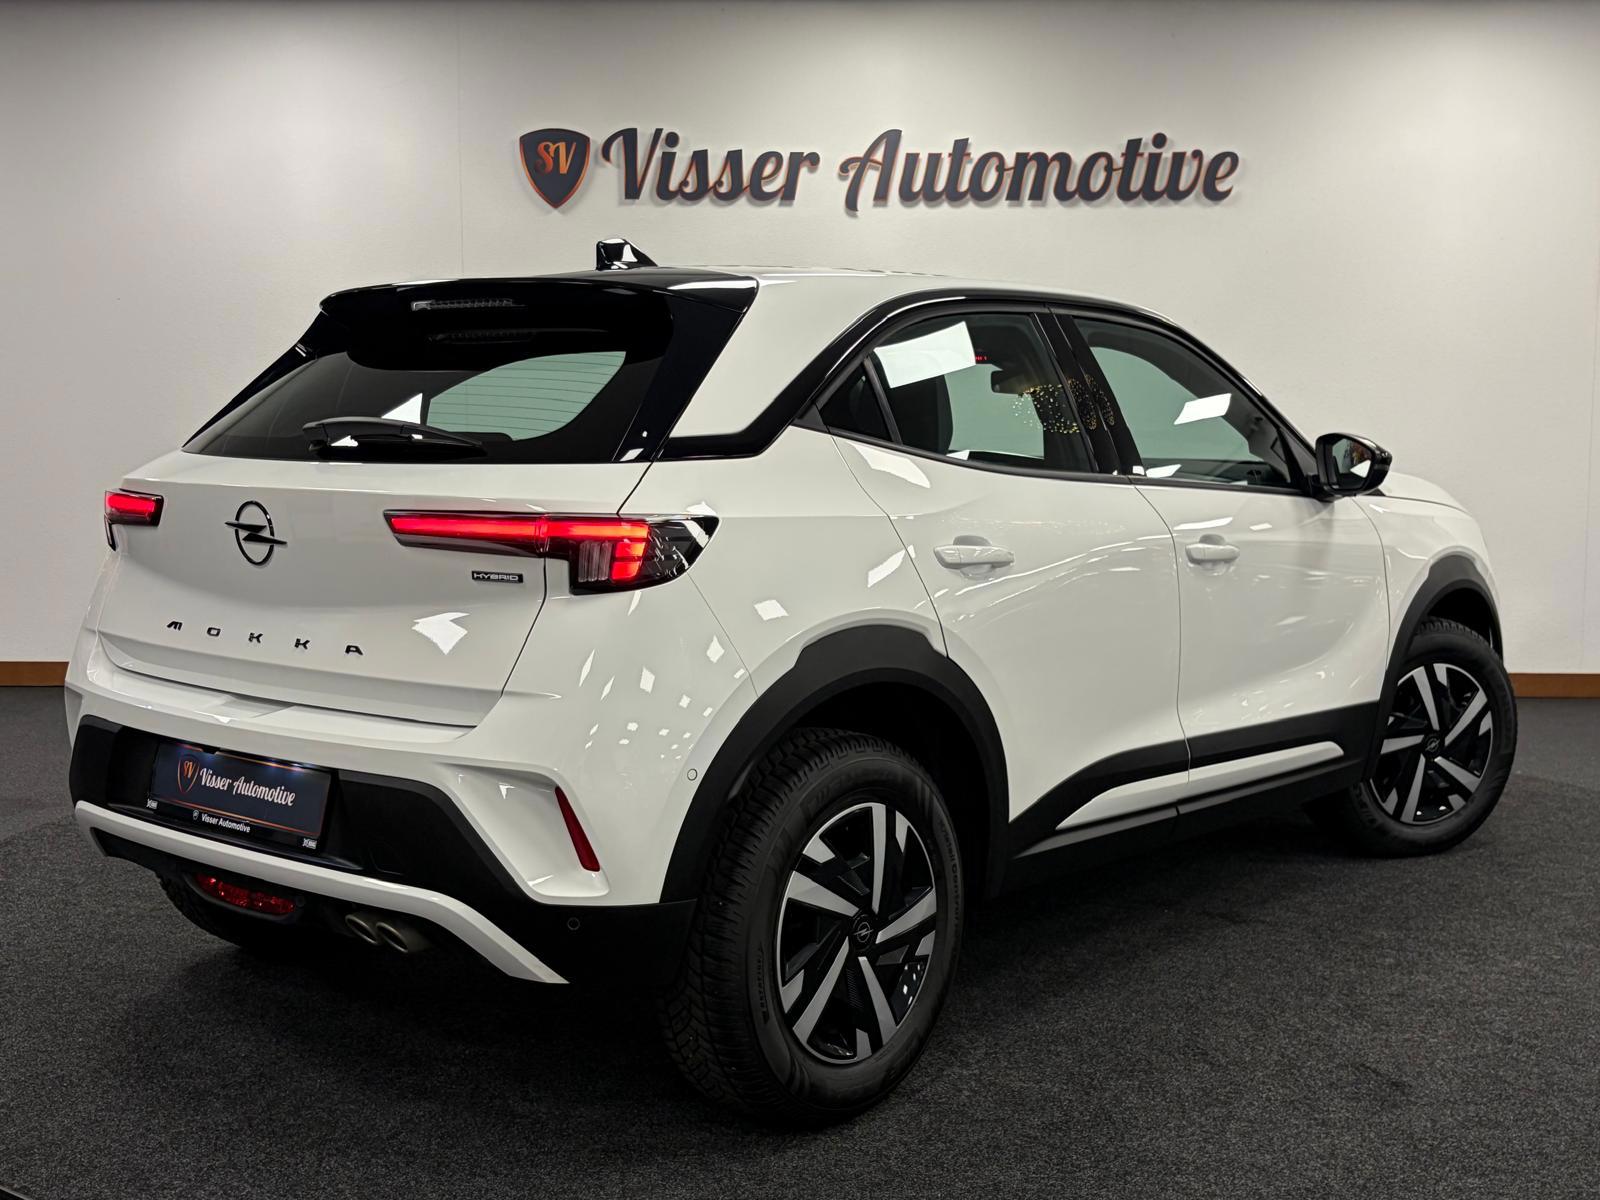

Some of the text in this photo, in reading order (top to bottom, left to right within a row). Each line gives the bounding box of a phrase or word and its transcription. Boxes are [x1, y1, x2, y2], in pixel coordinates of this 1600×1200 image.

[535, 140, 577, 175] SV
[602, 127, 1240, 213] Visser Automotive
[473, 572, 519, 581] HYBRID
[166, 620, 364, 656] MOKKA
[200, 767, 296, 807] Visser Automotive
[201, 813, 251, 833] Visser Automotive
